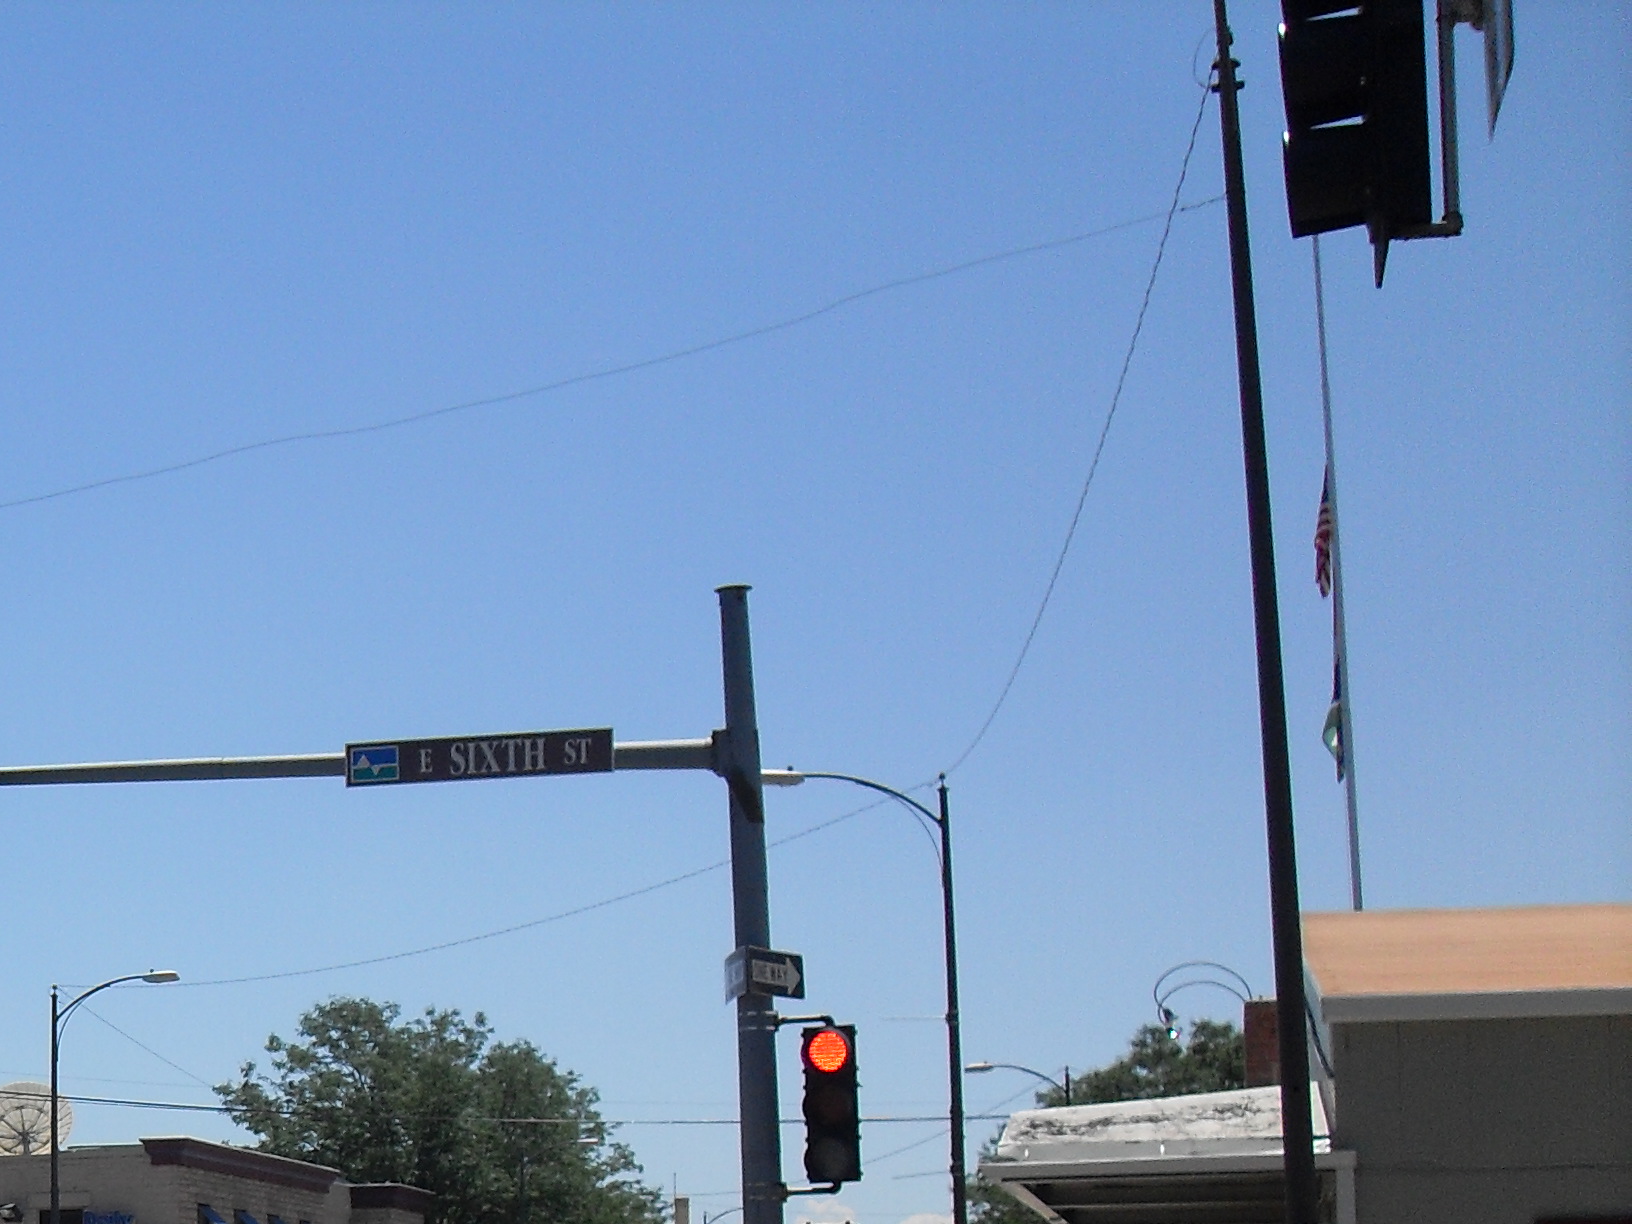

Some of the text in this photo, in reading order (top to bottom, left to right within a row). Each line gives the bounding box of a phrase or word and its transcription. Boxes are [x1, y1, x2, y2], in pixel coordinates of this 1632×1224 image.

[419, 737, 592, 776] E SIXTH ST
